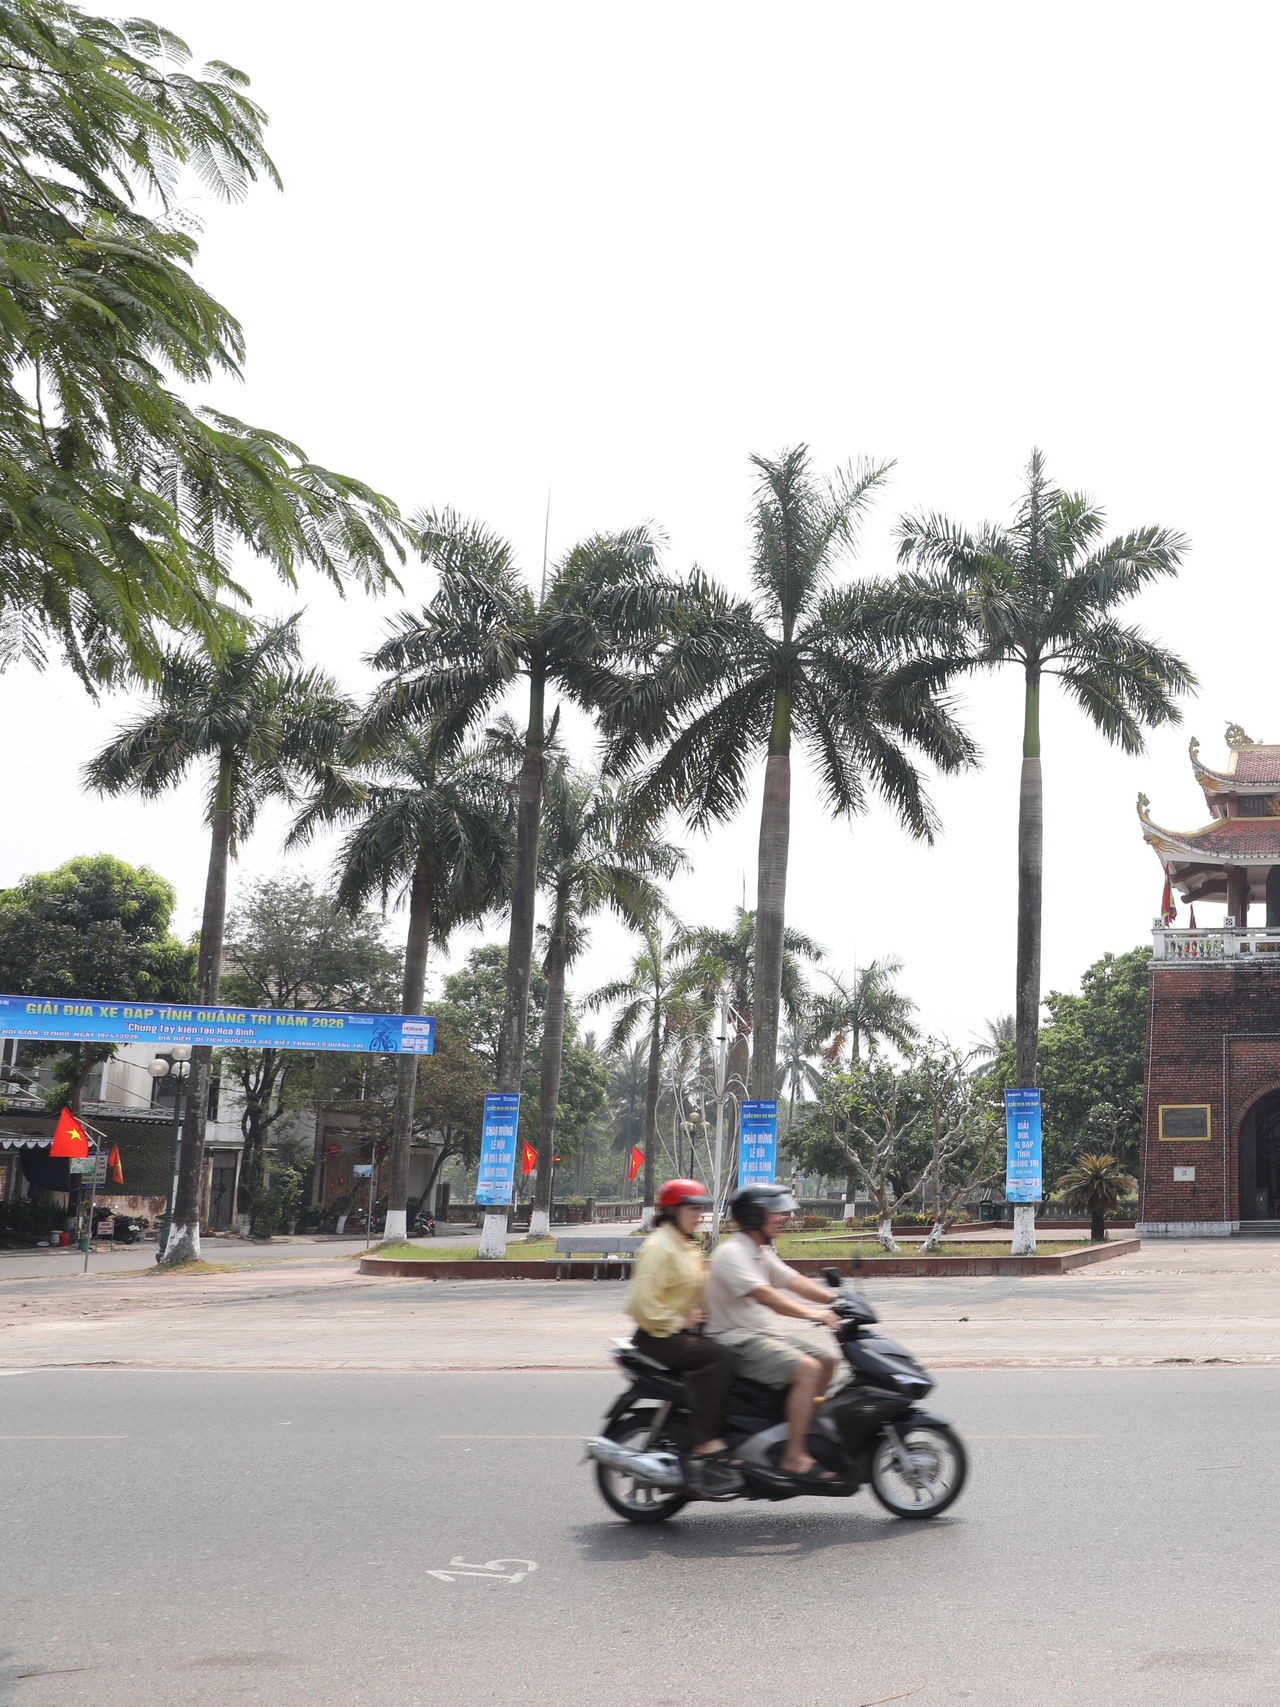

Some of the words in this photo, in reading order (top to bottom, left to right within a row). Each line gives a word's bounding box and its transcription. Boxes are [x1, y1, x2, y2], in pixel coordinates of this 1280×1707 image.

[26, 1000, 59, 1016] GIẢI
[63, 1005, 94, 1017] ĐUA
[99, 1007, 118, 1018] XE
[123, 1008, 155, 1022] ĐẠP
[158, 1007, 192, 1021] TỈNH
[197, 1010, 246, 1024] QUẢNG
[250, 1015, 271, 1028] TRỊ
[276, 1014, 308, 1026] NĂM
[312, 1018, 344, 1029] 2026
[160, 1025, 175, 1034] tay
[178, 1025, 198, 1034] kiến
[200, 1026, 214, 1035] tạo
